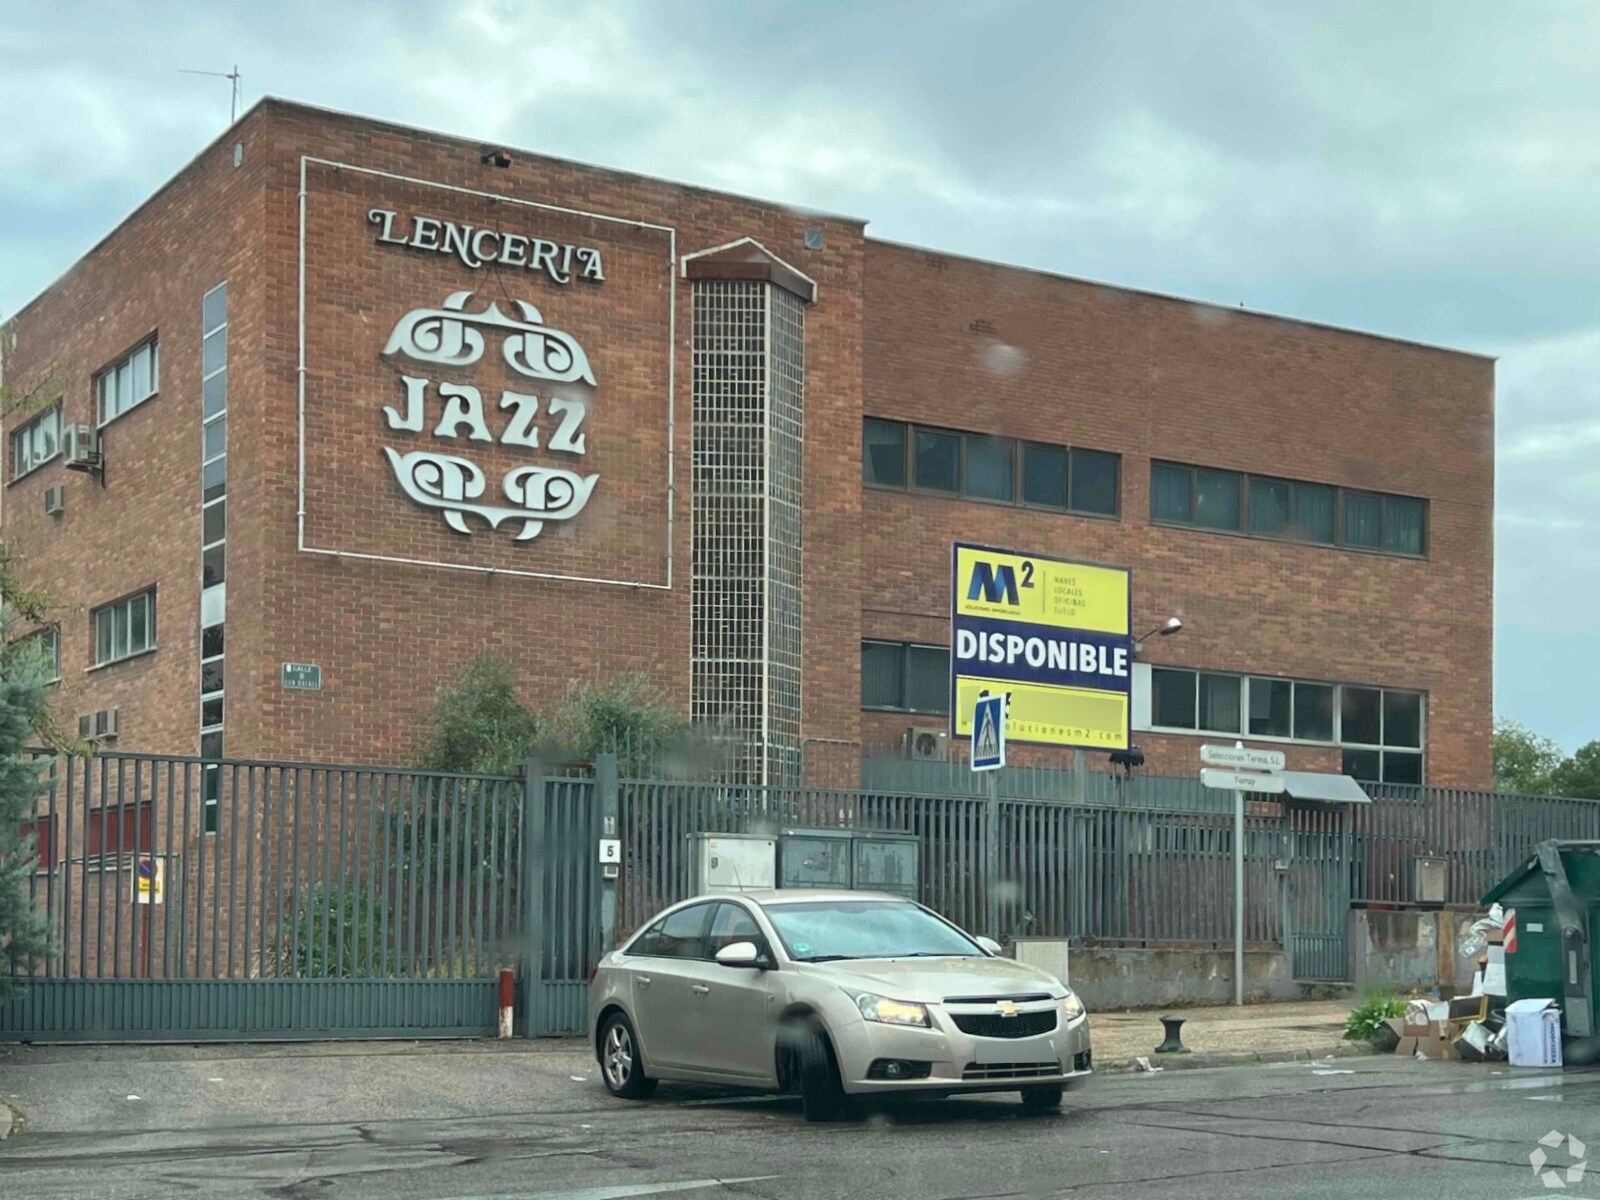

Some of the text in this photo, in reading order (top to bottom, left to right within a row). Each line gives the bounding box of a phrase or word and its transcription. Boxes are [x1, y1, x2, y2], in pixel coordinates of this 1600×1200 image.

[368, 209, 605, 284] LENCERIA
[383, 375, 586, 454] JAZZ
[1054, 576, 1076, 586] NAVES
[1054, 586, 1083, 597] LOCALES
[956, 629, 1129, 677] DISPONIBLE
[607, 845, 614, 857] 5
